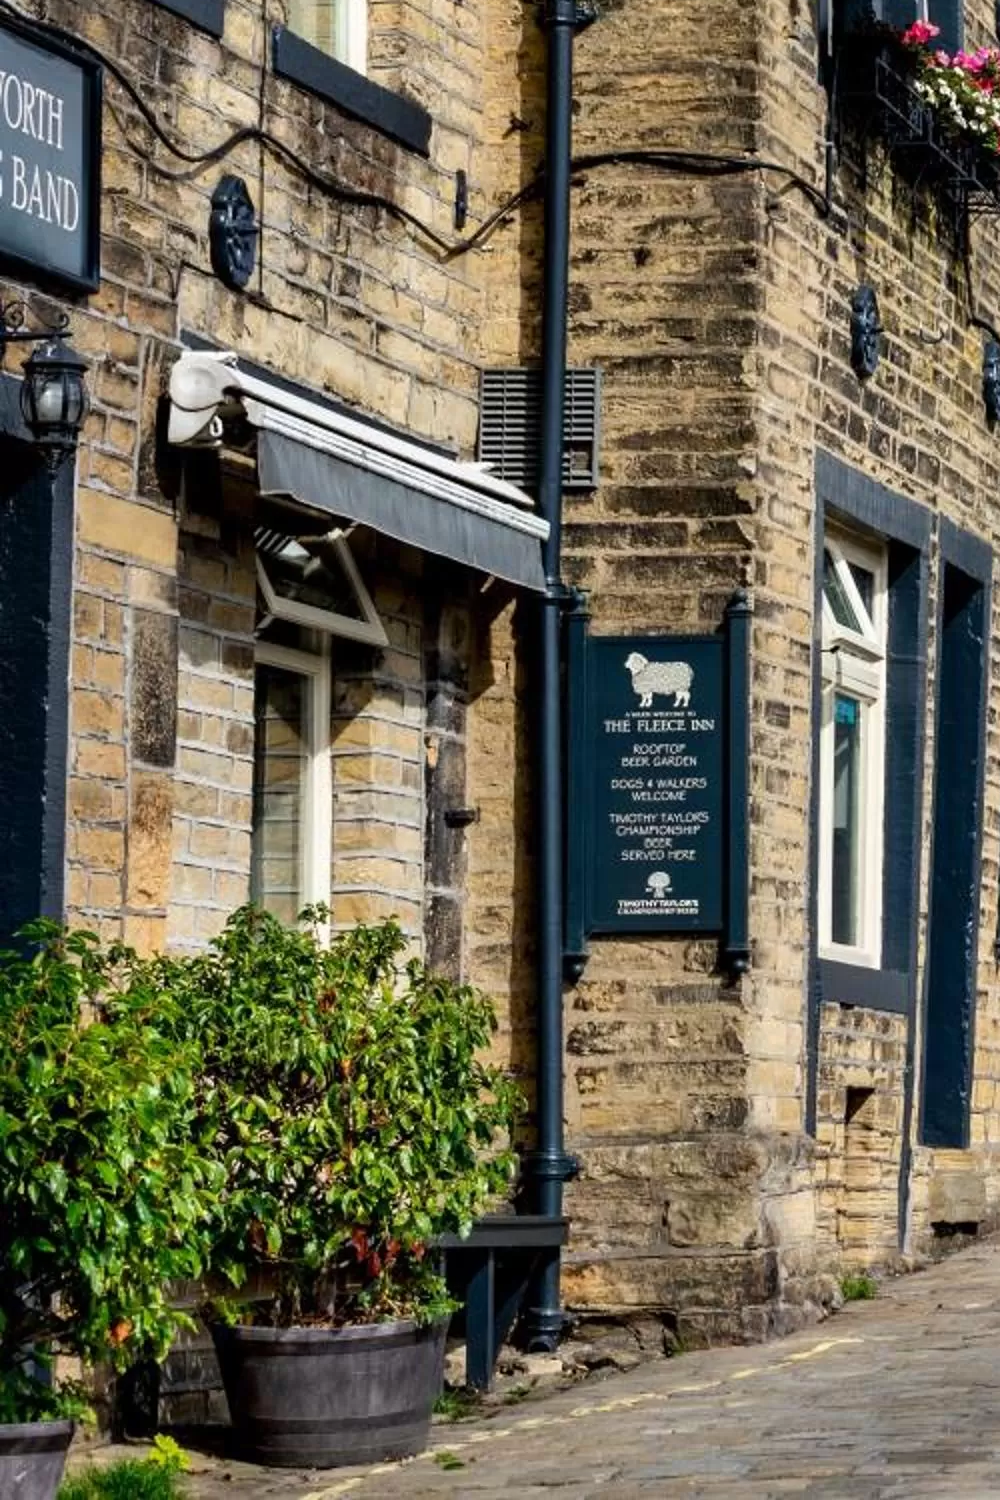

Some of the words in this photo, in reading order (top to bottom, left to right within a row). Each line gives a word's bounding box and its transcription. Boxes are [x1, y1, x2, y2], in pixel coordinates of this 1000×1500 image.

[11, 155, 79, 232] BAND
[604, 719, 631, 733] THE
[637, 719, 686, 733] FLEECE
[691, 719, 716, 731] INN
[633, 743, 686, 755] ROOFTOP
[621, 756, 650, 767] BEER
[653, 755, 698, 767] GARDEN
[611, 778, 644, 789] DOGS
[656, 777, 707, 789] WALKERS
[631, 790, 687, 801] WELCOME
[608, 812, 656, 823] TIMOTHY
[616, 825, 701, 837] CHAMPIONSHIP
[621, 850, 664, 861] SERVED
[668, 849, 697, 861] HERE
[617, 899, 658, 908] TIMOTHY
